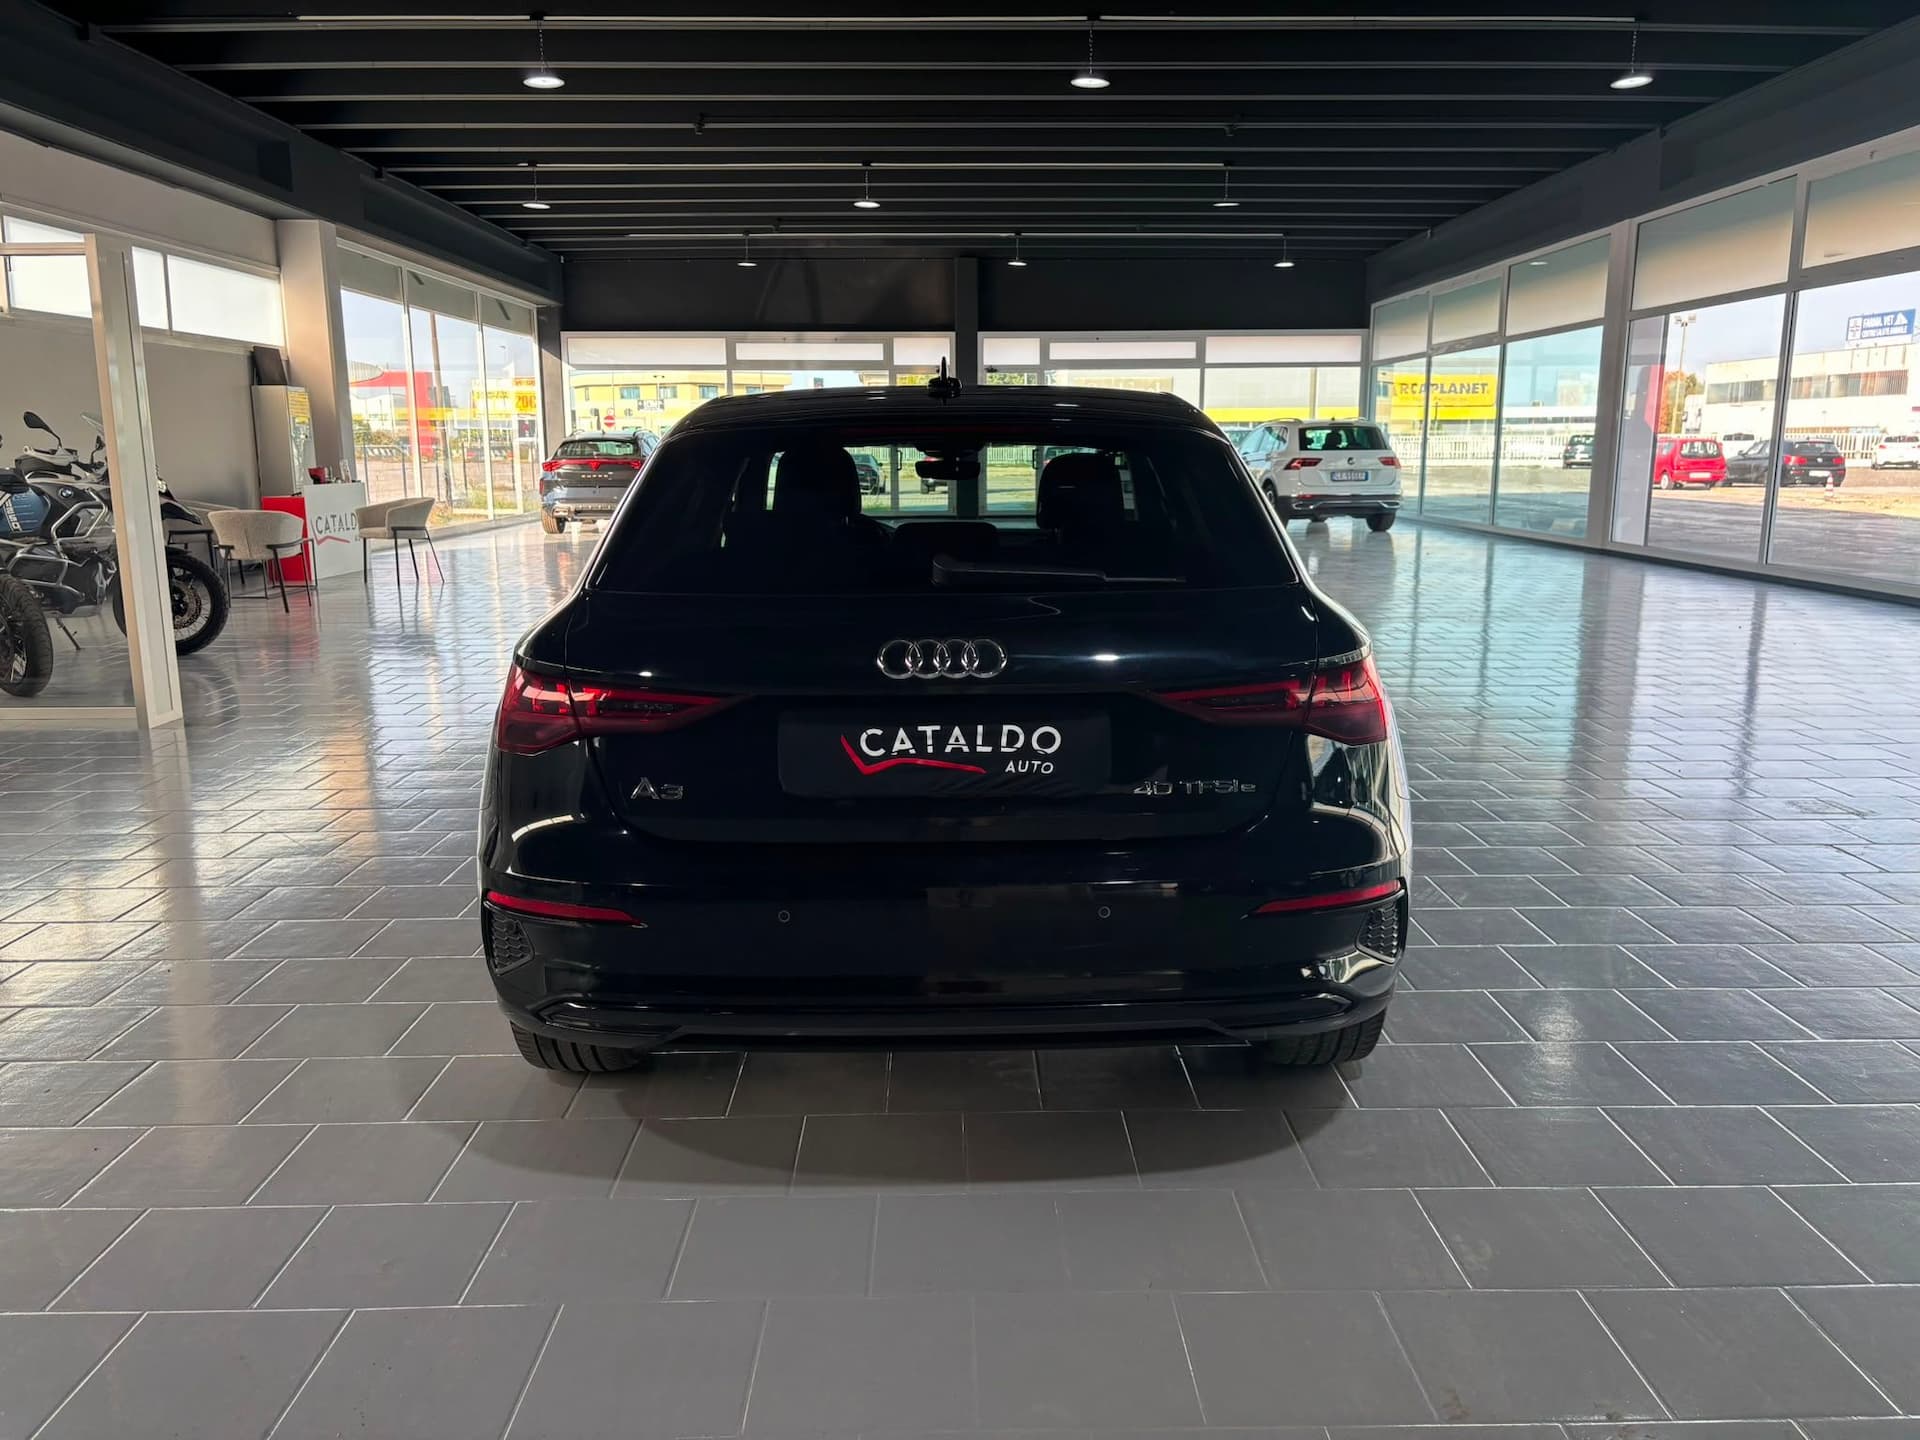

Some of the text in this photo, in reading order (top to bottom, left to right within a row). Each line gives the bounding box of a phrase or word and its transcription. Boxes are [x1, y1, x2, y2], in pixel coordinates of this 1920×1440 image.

[315, 512, 358, 535] CATALD
[859, 724, 1062, 757] CATALDO
[1005, 760, 1054, 774] AUTO
[630, 776, 684, 800] A3
[1133, 780, 1173, 796] 40
